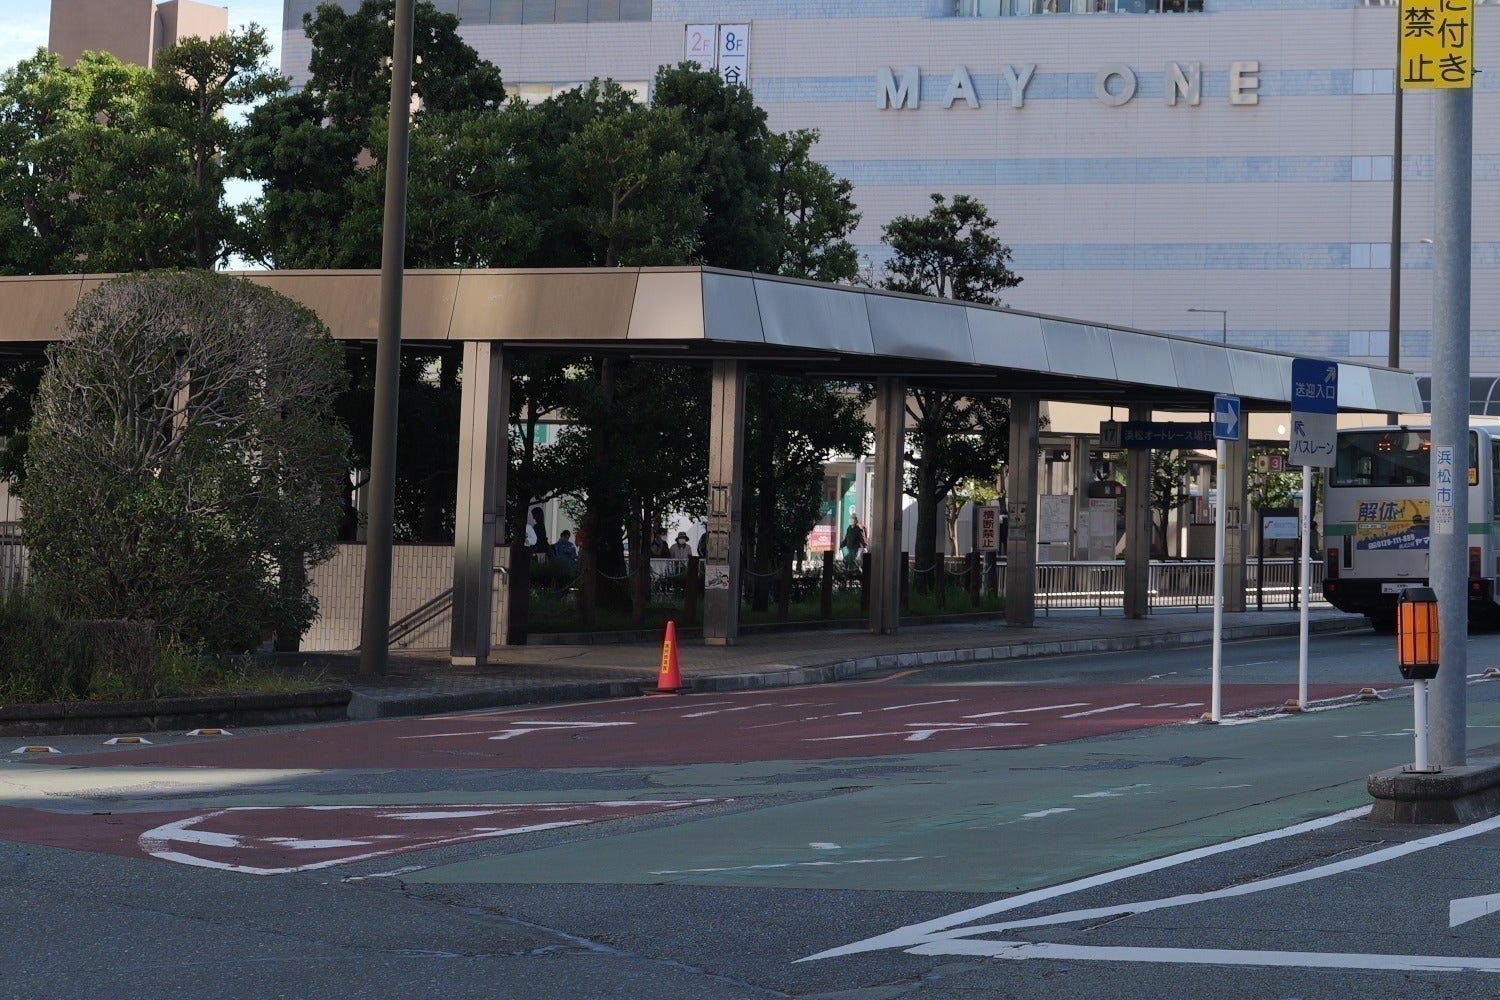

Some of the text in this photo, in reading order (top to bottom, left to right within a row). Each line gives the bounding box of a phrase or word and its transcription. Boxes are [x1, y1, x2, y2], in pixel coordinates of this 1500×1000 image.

[691, 31, 710, 52] 2F
[725, 32, 743, 52] 8F
[876, 60, 1259, 111] MAY ONE
[1295, 382, 1335, 401] 送迎入口
[1294, 440, 1334, 455] バスレーン
[1437, 450, 1452, 503] 浜松市
[1358, 501, 1398, 521] 解体
[982, 510, 994, 548] 横断禁止
